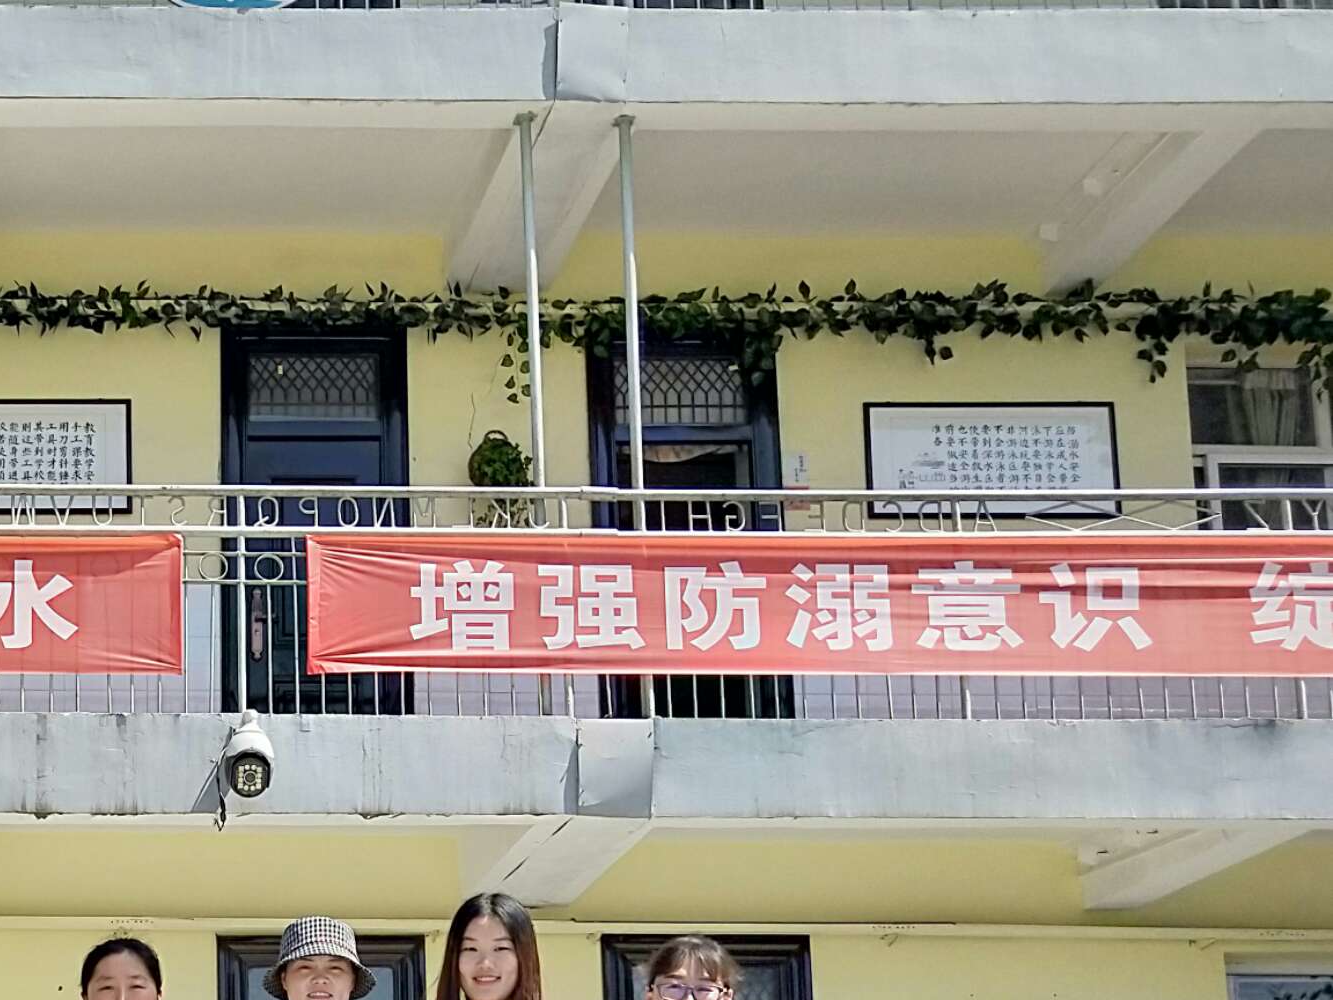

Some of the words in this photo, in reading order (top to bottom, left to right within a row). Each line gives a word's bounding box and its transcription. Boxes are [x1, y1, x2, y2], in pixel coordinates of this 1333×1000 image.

[409, 559, 1153, 653] 增强防溺意识
